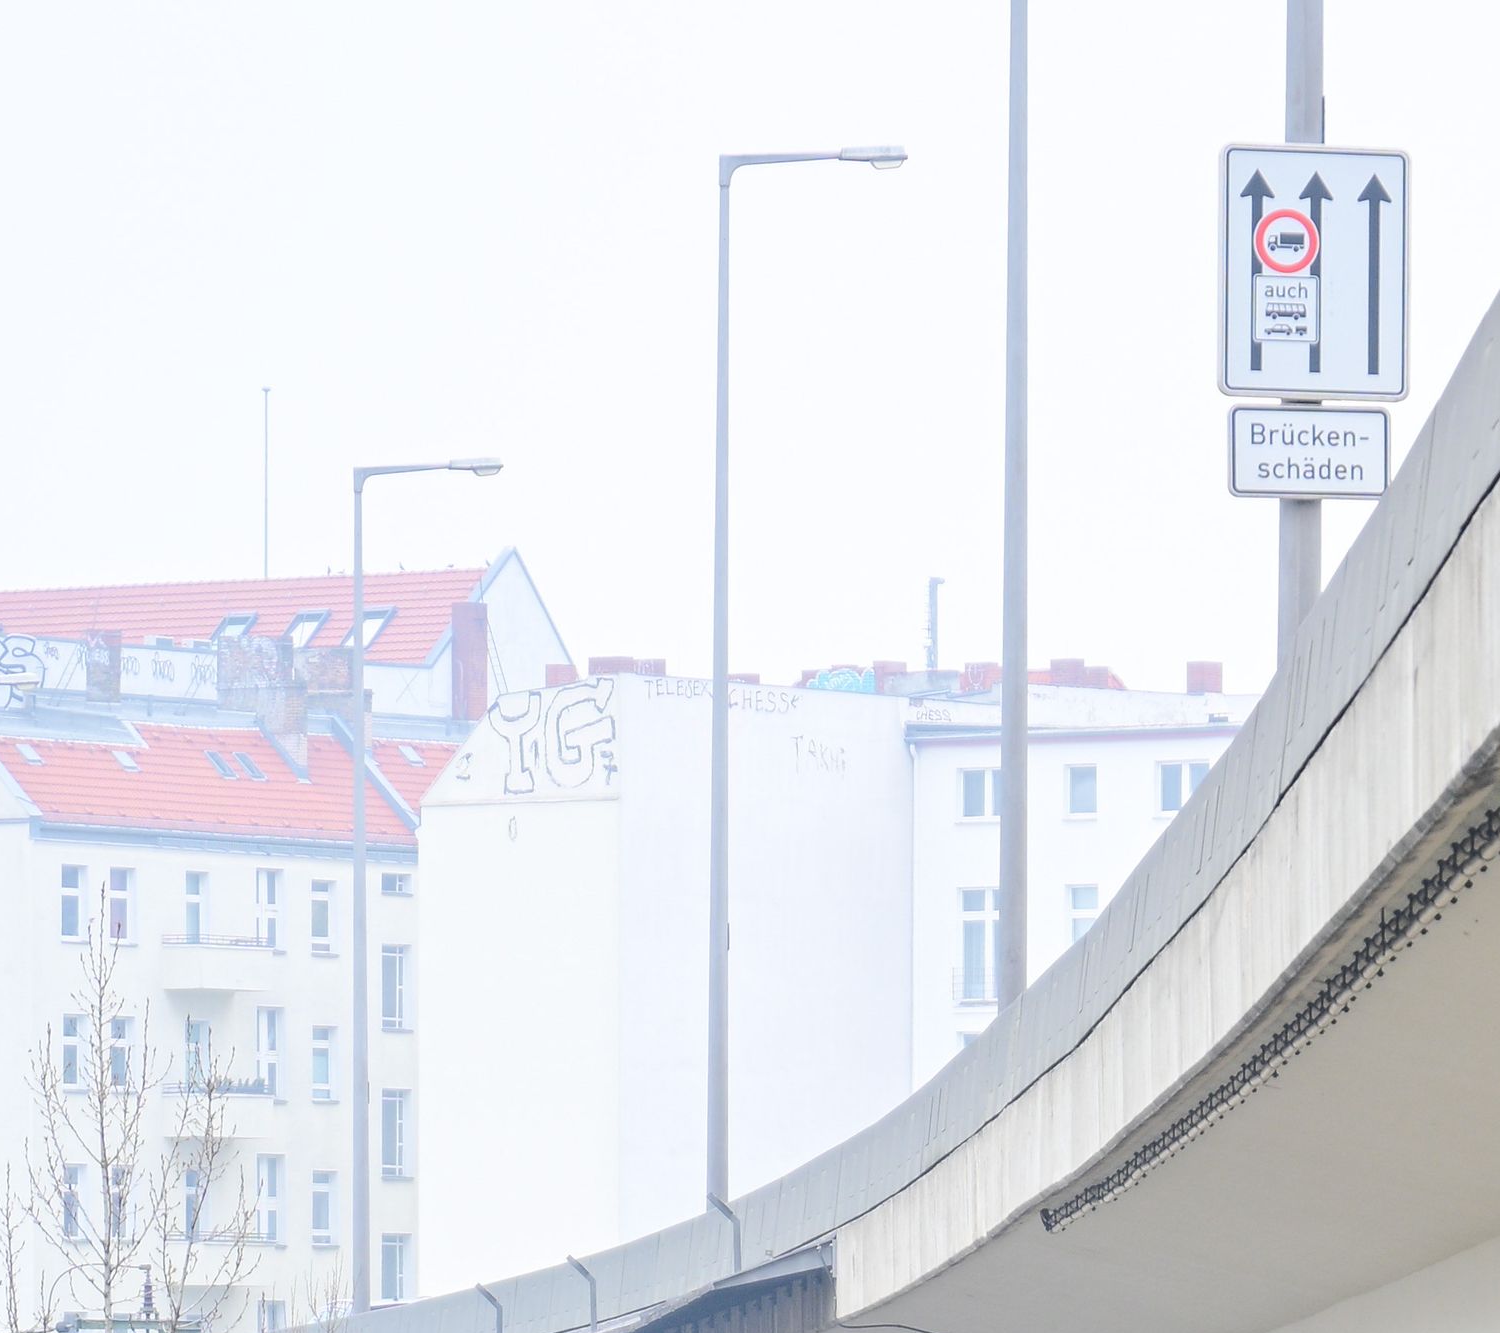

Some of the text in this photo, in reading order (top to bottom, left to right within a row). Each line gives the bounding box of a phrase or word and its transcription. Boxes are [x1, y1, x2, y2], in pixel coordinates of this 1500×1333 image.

[1264, 282, 1308, 300] auch
[1250, 423, 1370, 447] Brücken-
[1257, 458, 1364, 481] schäden
